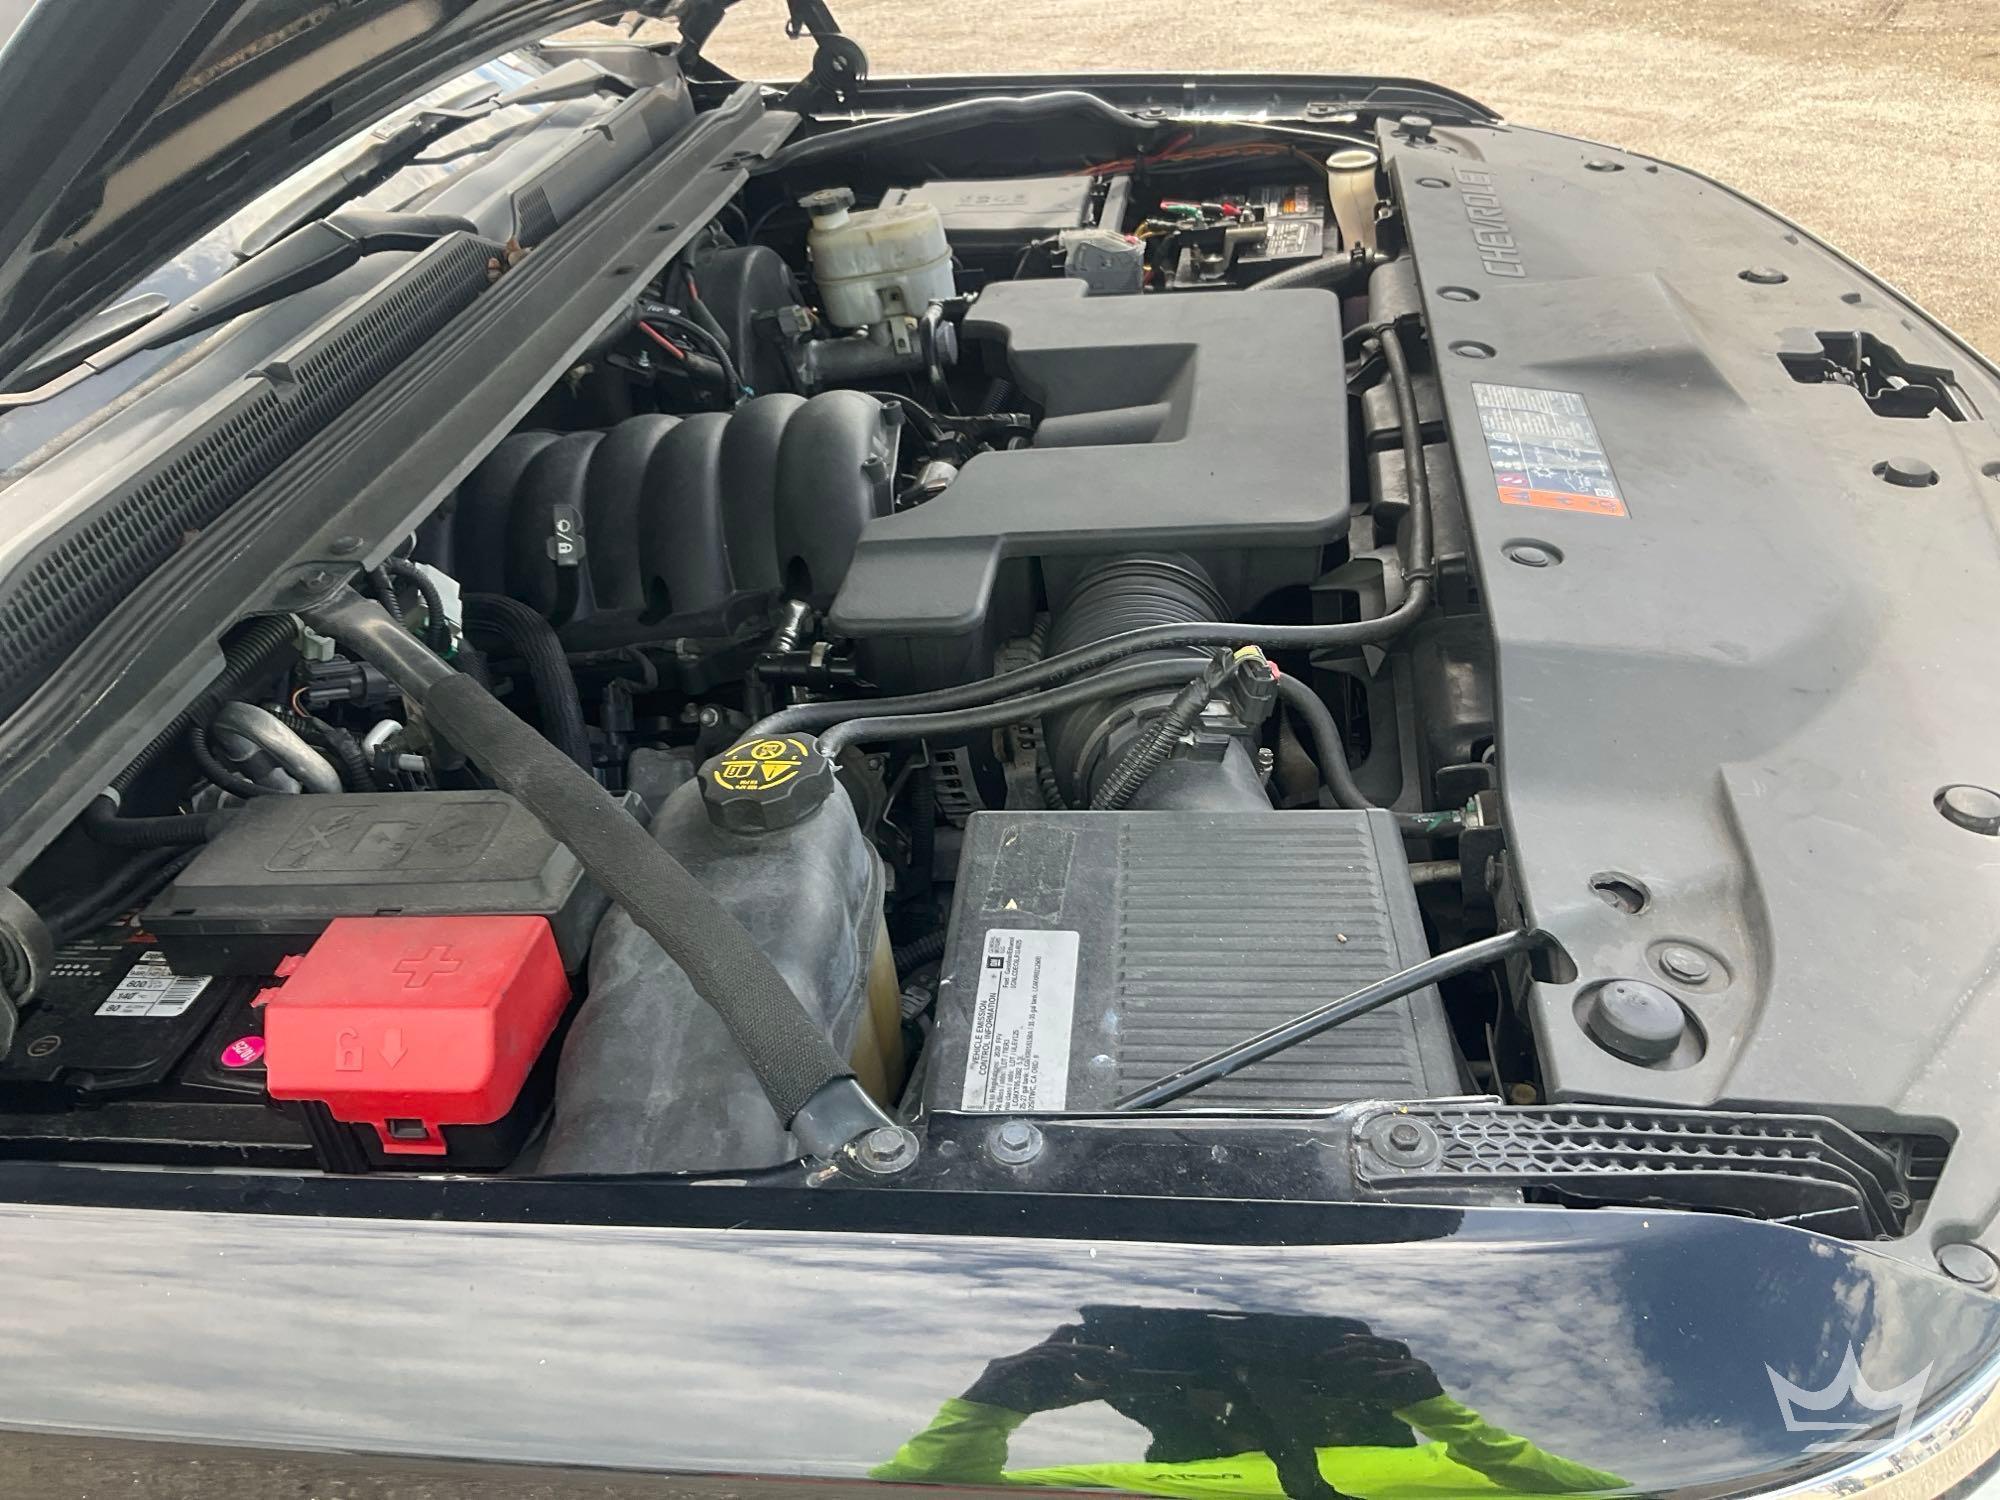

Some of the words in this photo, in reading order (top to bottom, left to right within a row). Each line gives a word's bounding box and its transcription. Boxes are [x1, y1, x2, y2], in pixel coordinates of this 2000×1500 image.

[1455, 167, 1526, 278] CHEVROLET
[976, 1000, 988, 1033] EMISSION
[984, 992, 997, 1040] INFORMATION
[972, 1036, 983, 1064] VEHICLE
[979, 1042, 991, 1076] CONTROL
[1031, 1074, 1038, 1084] CA
